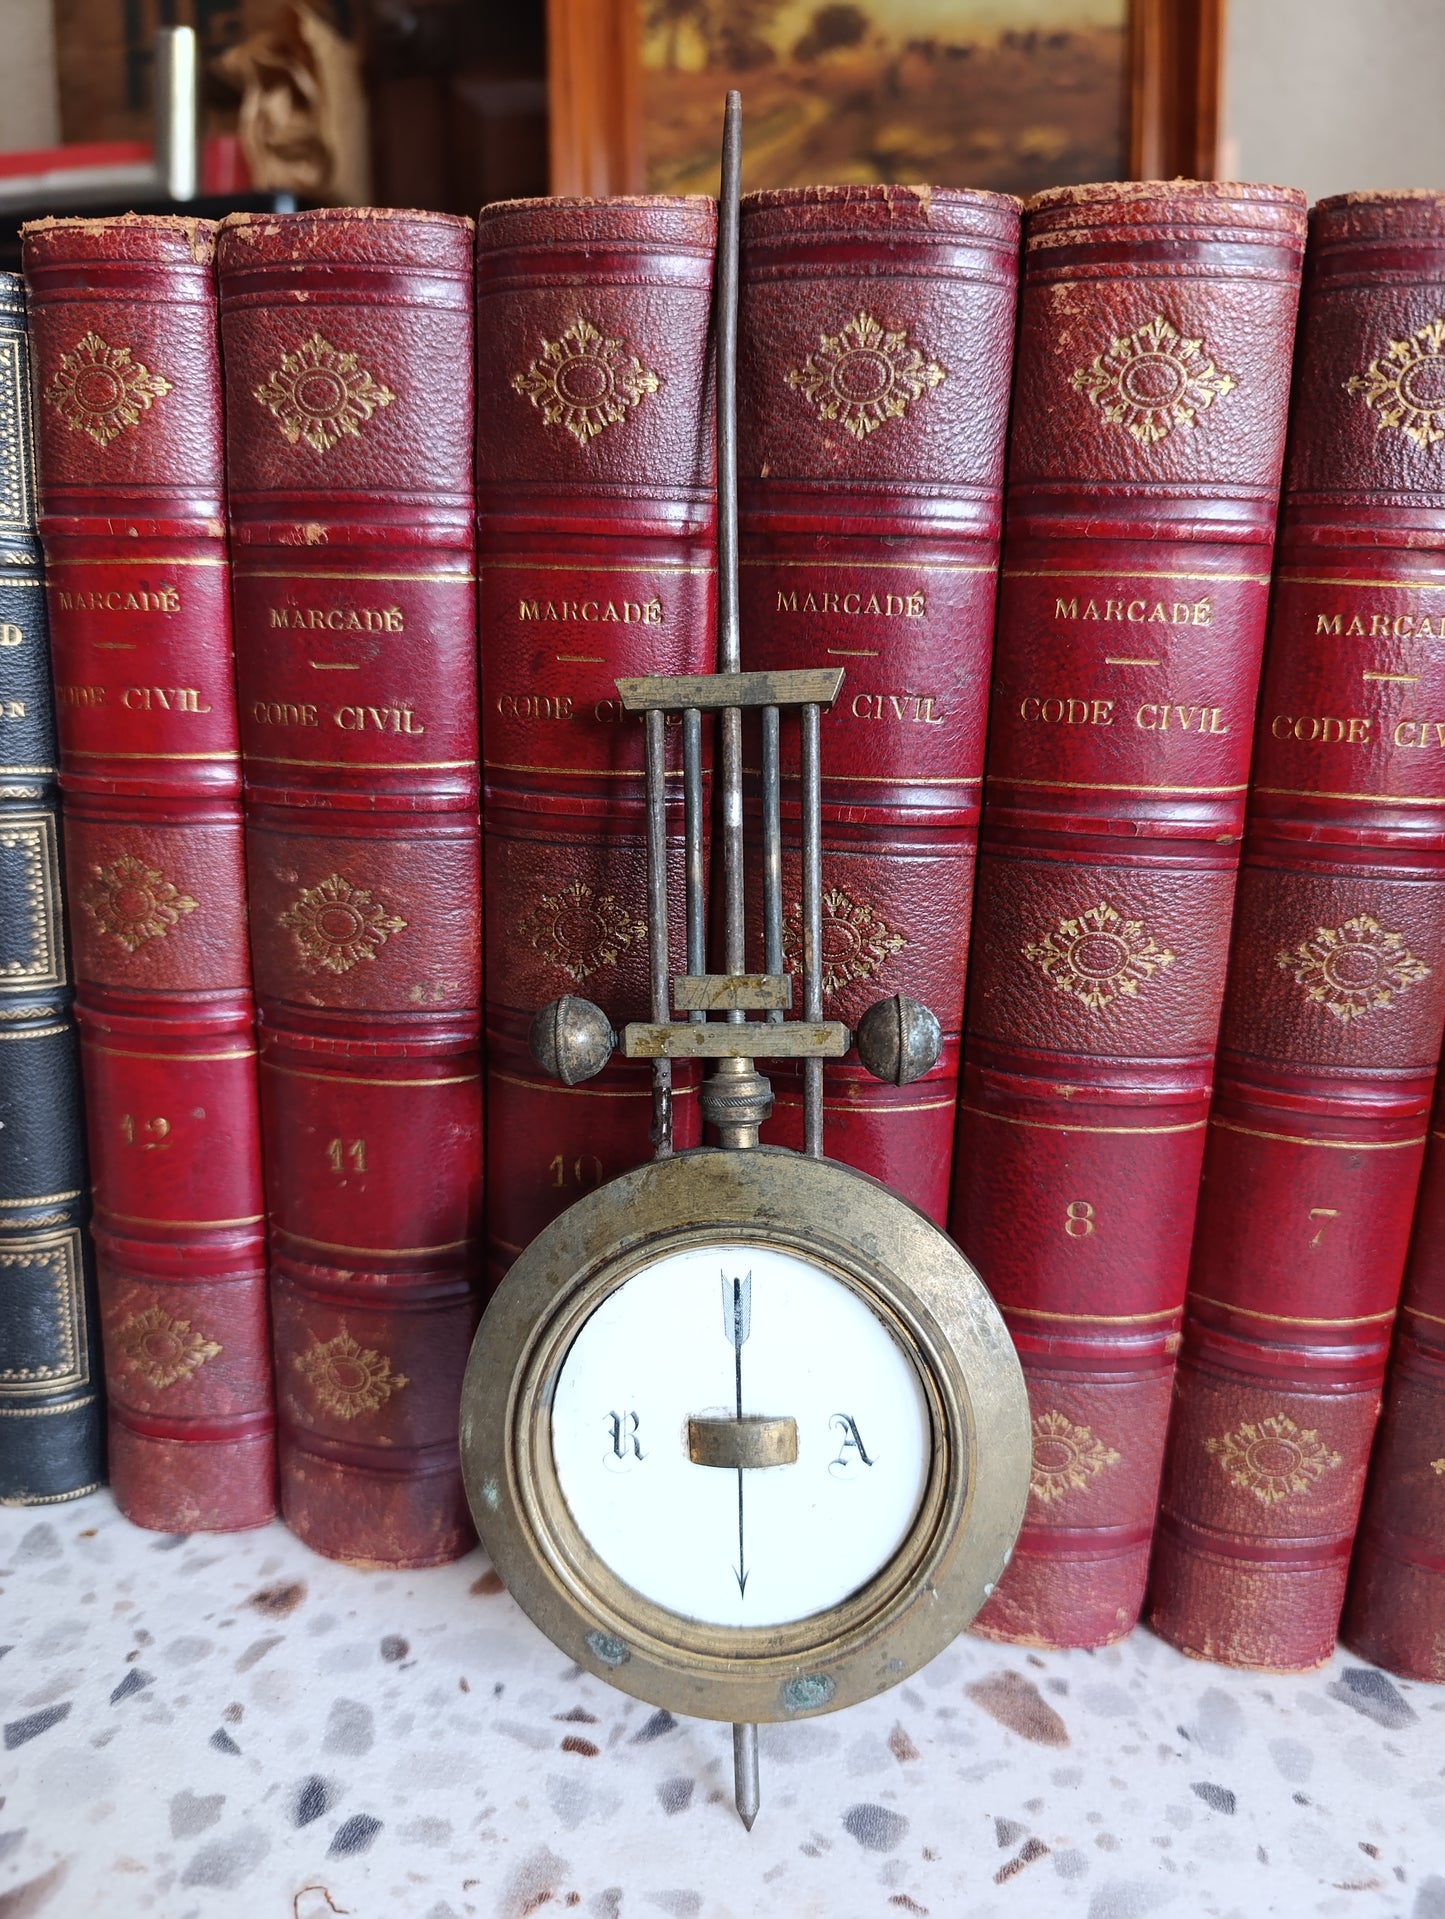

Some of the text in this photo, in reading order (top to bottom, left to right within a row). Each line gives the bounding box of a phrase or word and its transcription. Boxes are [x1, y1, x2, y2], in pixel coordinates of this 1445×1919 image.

[59, 587, 181, 612] MARCADÉ
[519, 599, 663, 625] MARCADÉ
[776, 588, 926, 618] MARCADÉ
[1054, 596, 1213, 626] MARCADÉ
[270, 606, 404, 632] MARCADÉ
[123, 687, 212, 713] CIVIL
[497, 695, 573, 720] CODE
[852, 693, 944, 724] CIVIL
[254, 702, 424, 734] CODE CIVIL
[1020, 697, 1228, 734] CODE CIVIL
[1271, 715, 1374, 743] CODE
[120, 1113, 172, 1150] 12
[326, 1137, 368, 1173] 11
[1064, 1201, 1095, 1238] 8
[1308, 1207, 1341, 1249] 7
[828, 1412, 880, 1481] A
